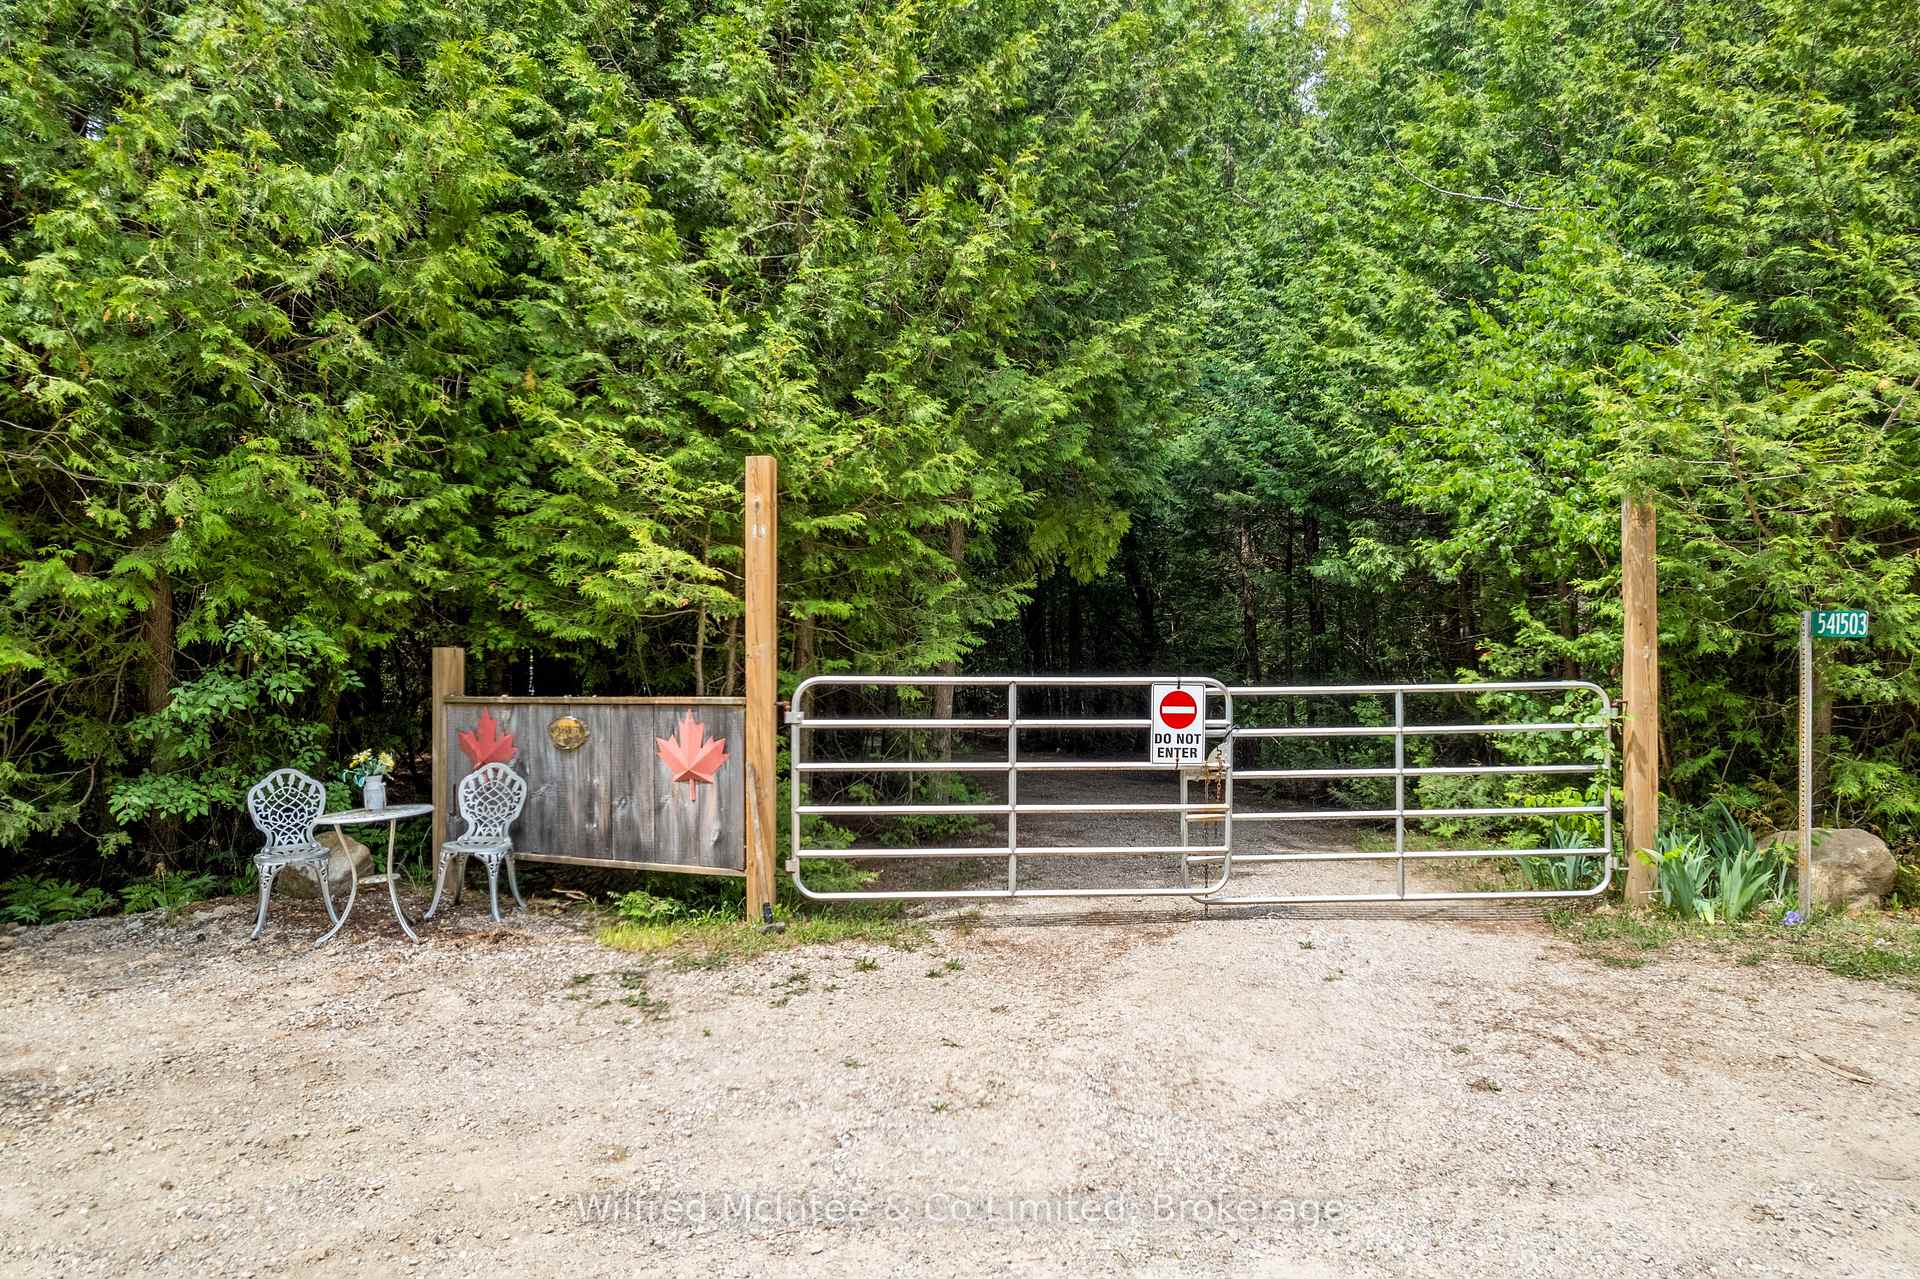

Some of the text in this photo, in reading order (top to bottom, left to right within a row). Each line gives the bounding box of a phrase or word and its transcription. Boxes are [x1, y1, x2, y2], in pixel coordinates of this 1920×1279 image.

[1817, 613, 1867, 635] 541503
[1155, 733, 1201, 744] DO NOT
[1157, 747, 1198, 758] ENTER
